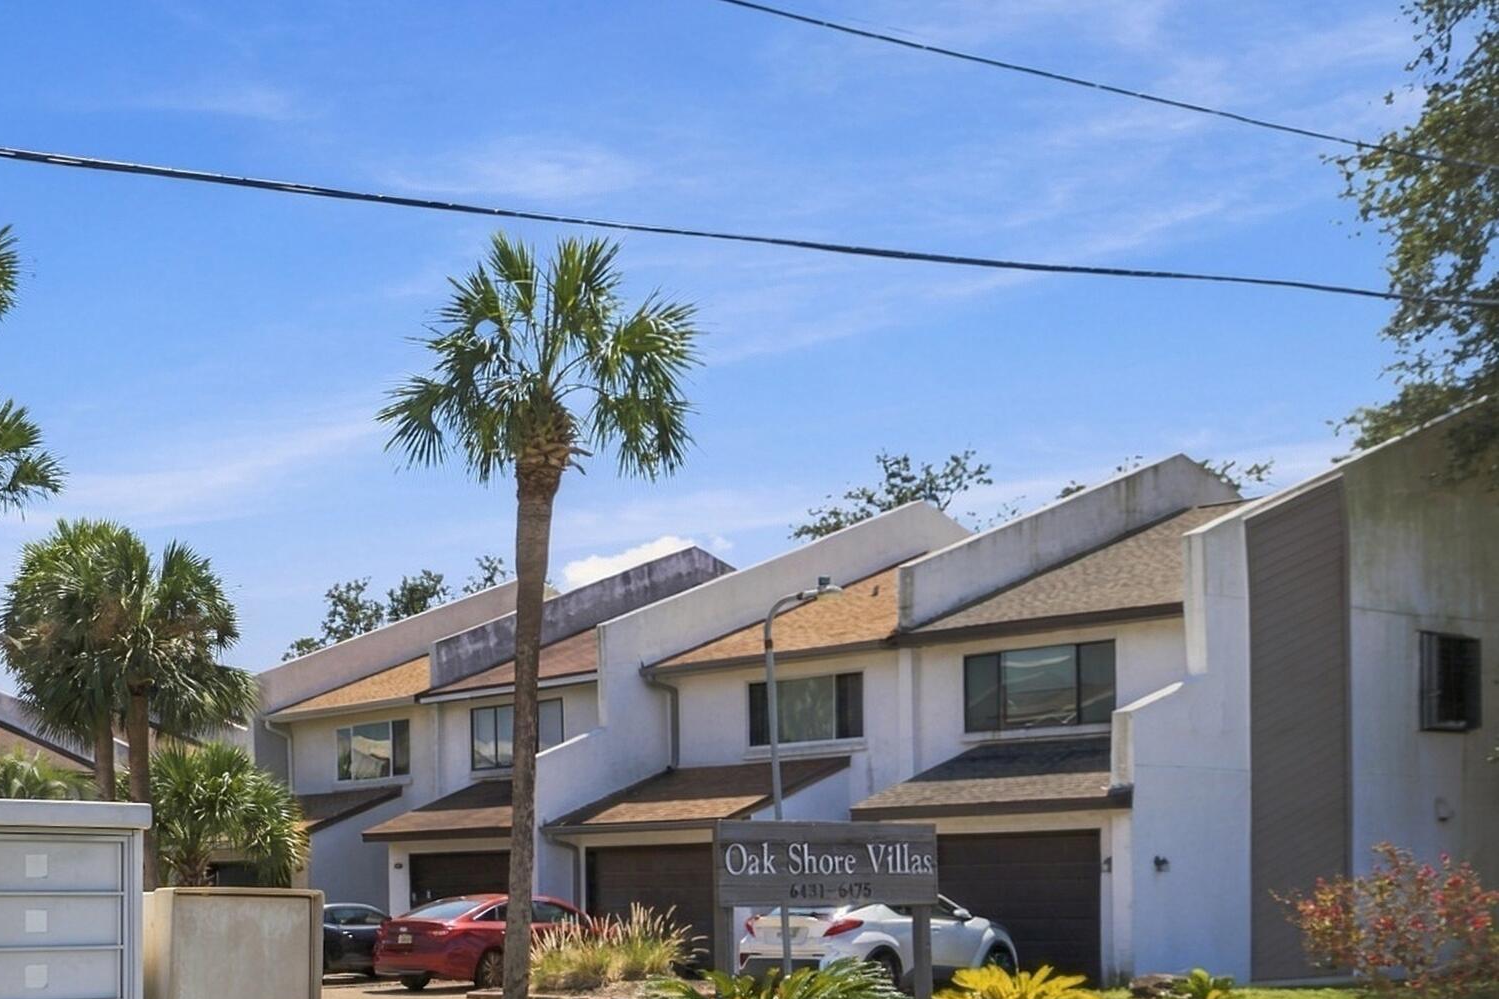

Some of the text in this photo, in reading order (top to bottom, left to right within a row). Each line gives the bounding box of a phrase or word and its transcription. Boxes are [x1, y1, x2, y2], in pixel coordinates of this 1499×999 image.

[725, 842, 934, 876] Oak Shore Villas
